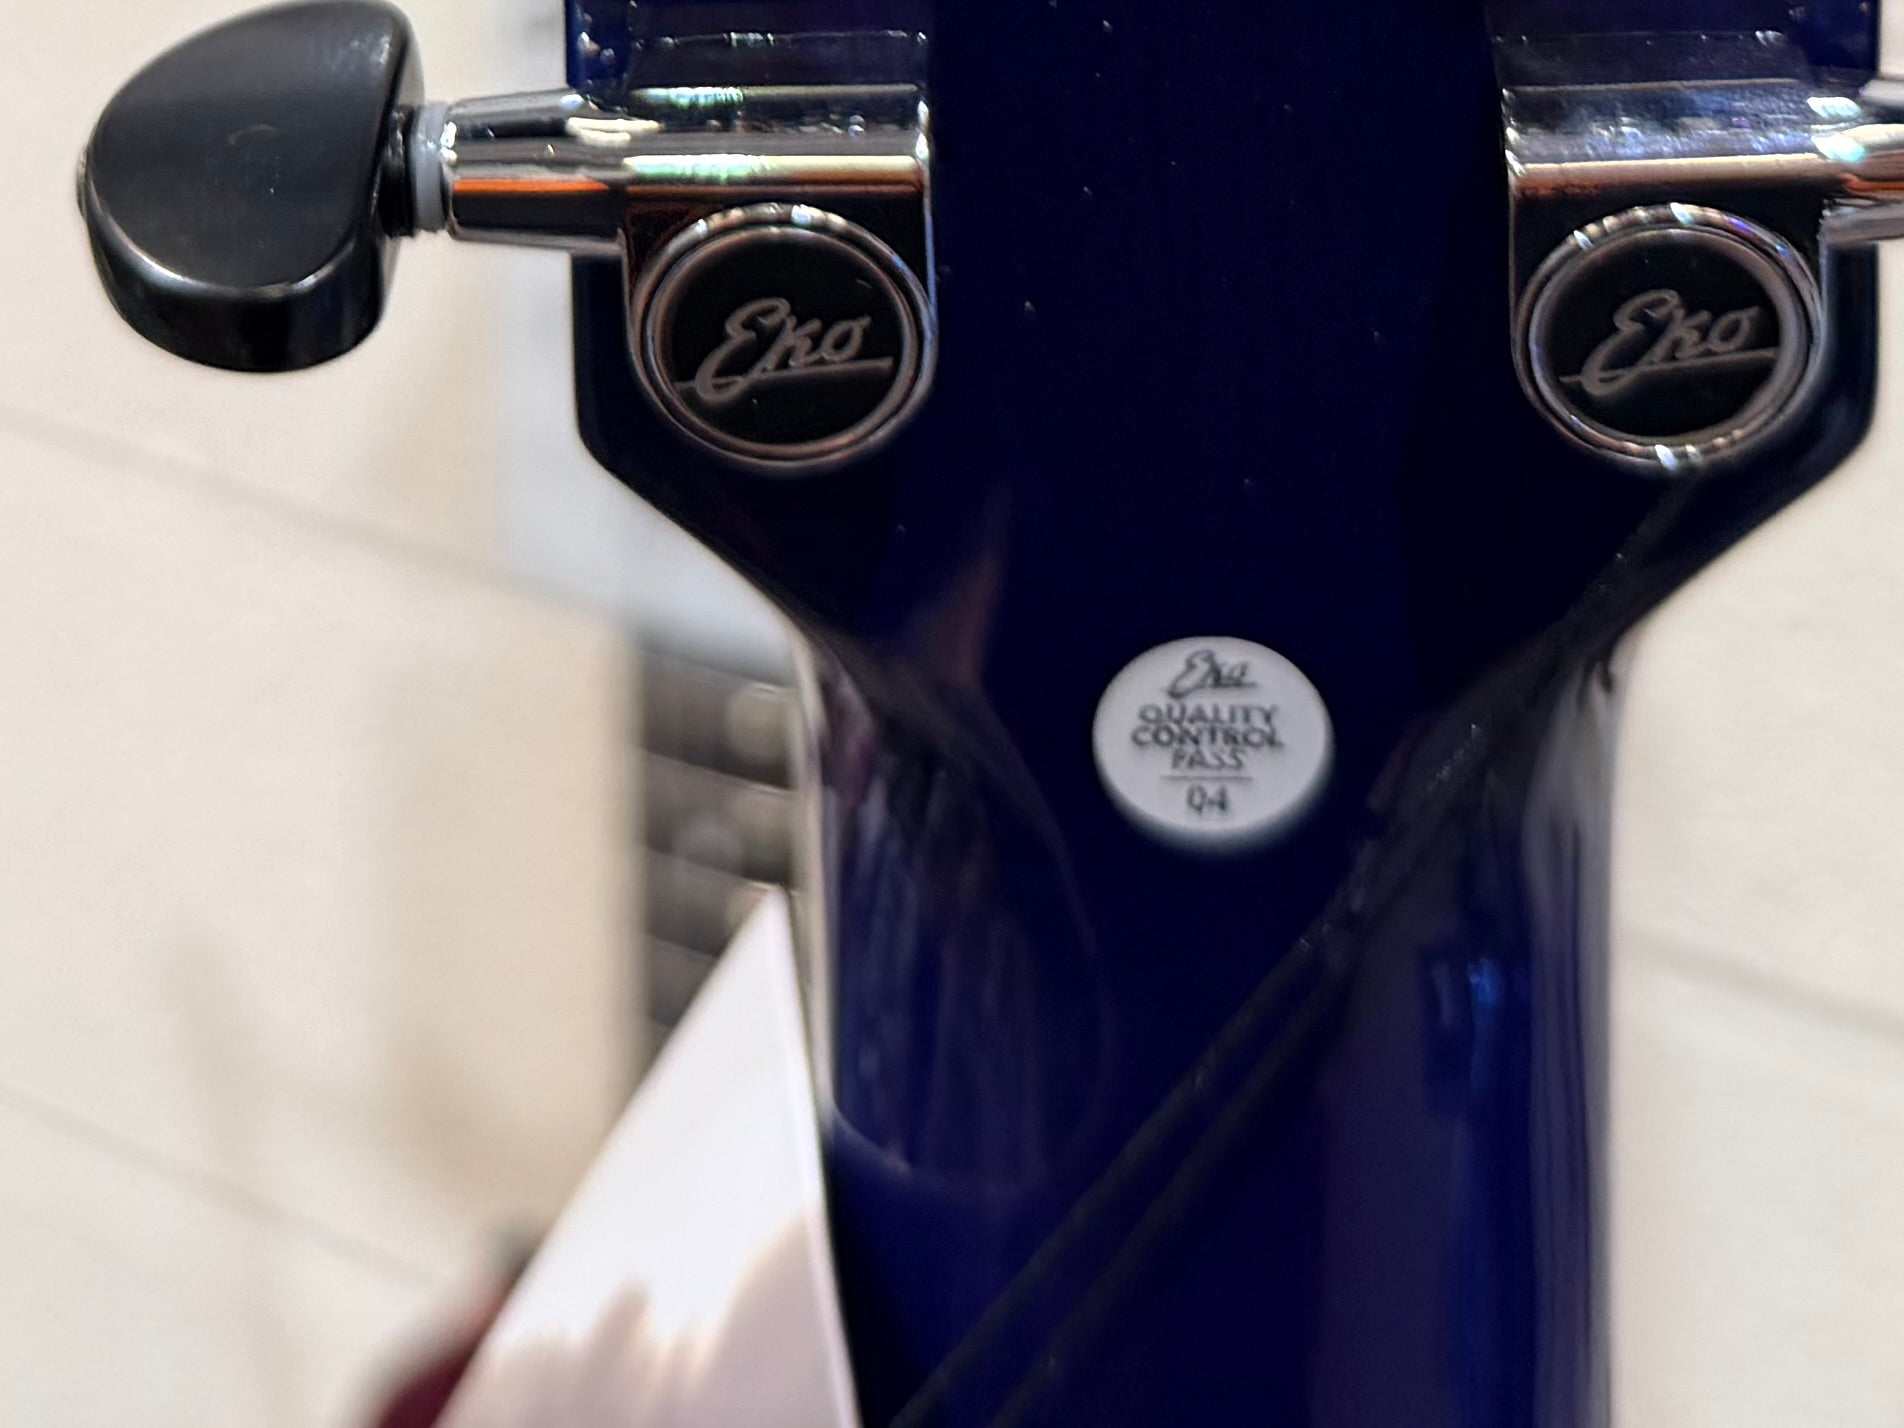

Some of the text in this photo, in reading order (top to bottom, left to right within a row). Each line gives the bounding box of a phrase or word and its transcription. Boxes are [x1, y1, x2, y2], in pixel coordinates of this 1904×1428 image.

[694, 296, 869, 402] Eko
[1579, 287, 1759, 395] Eko
[1138, 704, 1279, 724] QUALITY
[1131, 724, 1283, 748] CONTROL
[1171, 748, 1245, 770] PASS
